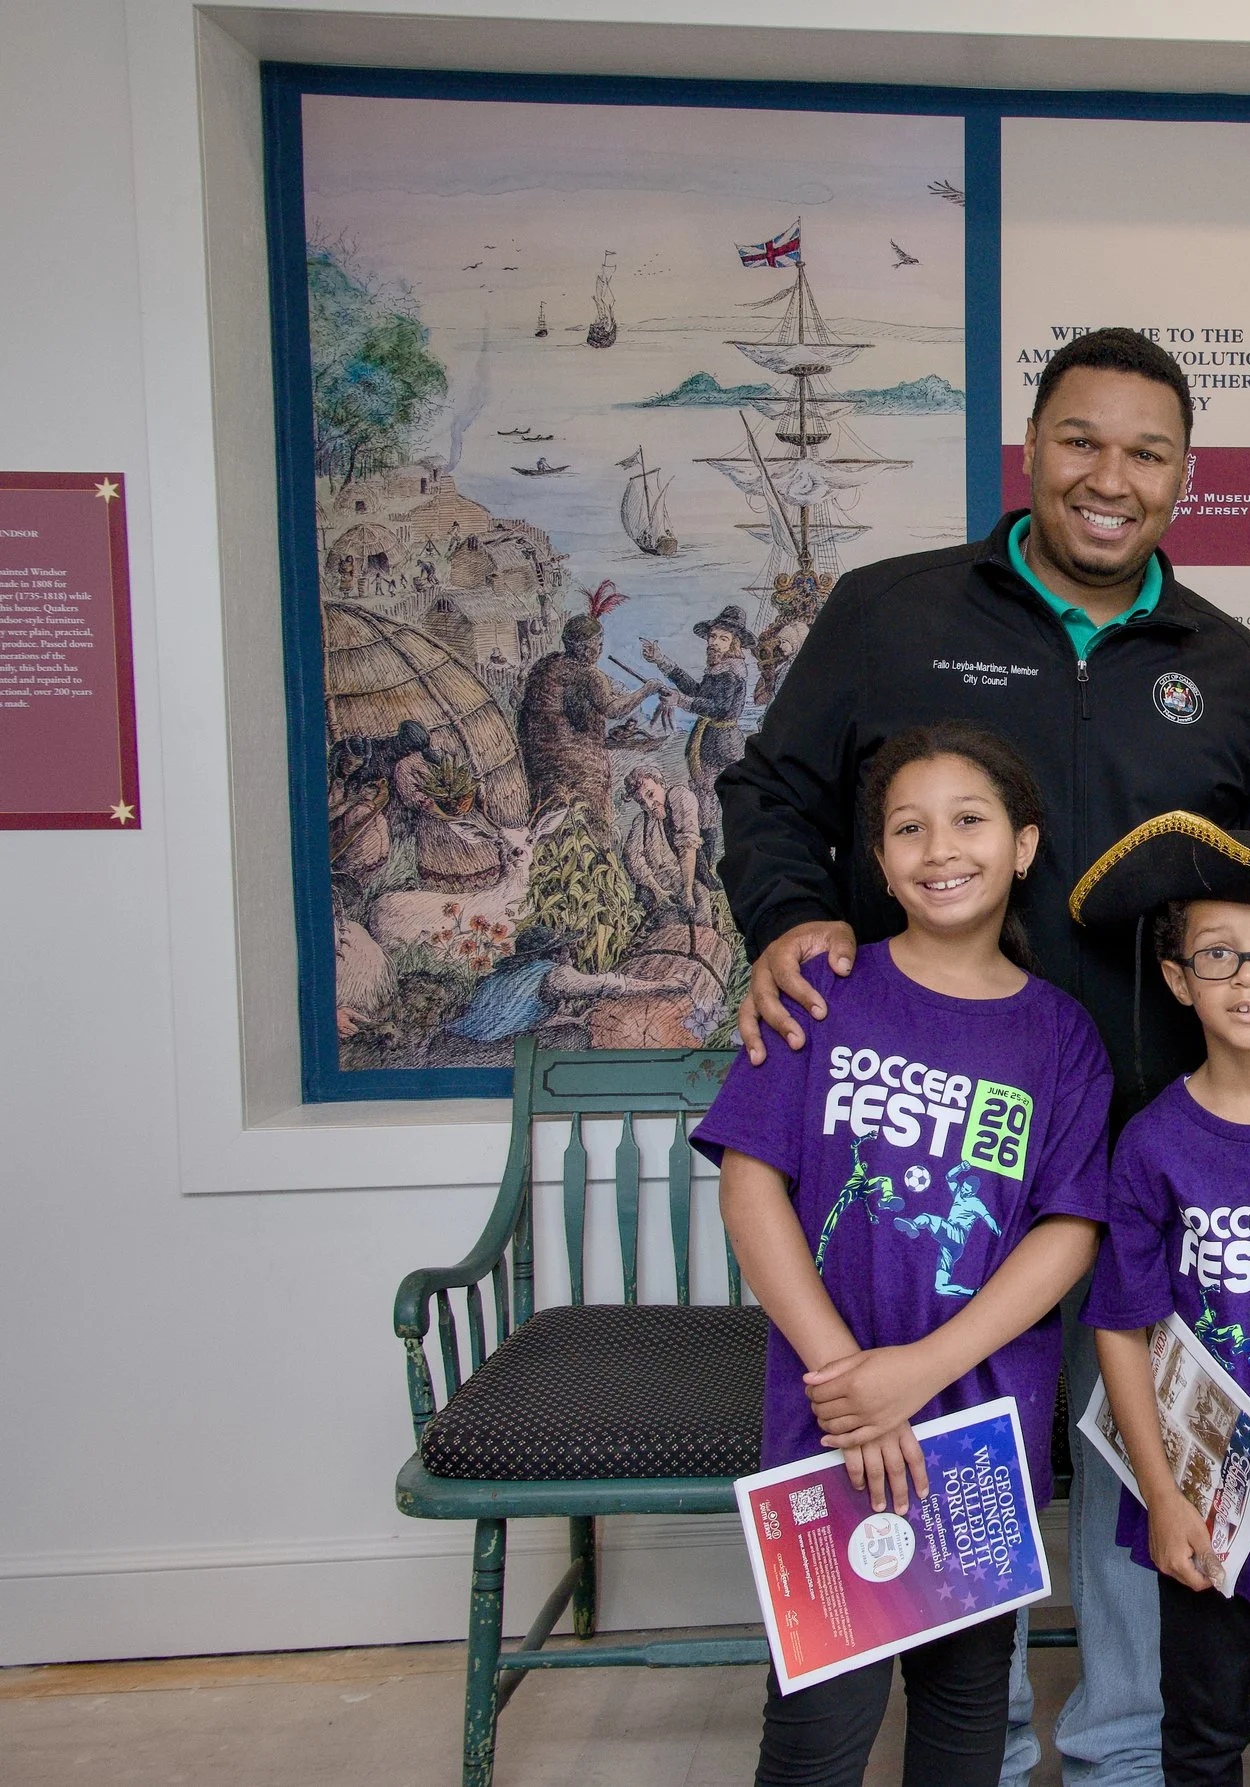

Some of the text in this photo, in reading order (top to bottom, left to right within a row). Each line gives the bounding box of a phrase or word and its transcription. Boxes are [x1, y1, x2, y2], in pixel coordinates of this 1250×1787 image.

[1166, 328, 1195, 343] TO
[1201, 328, 1244, 343] THE
[1197, 505, 1249, 515] JERSEY
[0, 530, 39, 538] INDSOR
[0, 567, 67, 576] ainted Windsor
[20, 580, 29, 588] in
[32, 580, 53, 588] 1808
[54, 580, 67, 588] for
[69, 591, 92, 600] while
[0, 604, 79, 614] his house. Quakers
[0, 615, 85, 626] ndsor-style furniture
[28, 627, 53, 638] plain,
[55, 627, 94, 638] practical,
[2, 640, 94, 650] produce. Passed down
[41, 652, 51, 660] of
[52, 652, 66, 660] the
[19, 664, 35, 672] this
[36, 664, 62, 672] bench
[64, 664, 78, 672] has
[1010, 664, 1039, 676] Member
[19, 676, 35, 684] and
[37, 676, 71, 686] repaired
[963, 673, 1008, 686] City Council
[0, 688, 32, 696] ctional,
[53, 688, 70, 696] 200
[71, 690, 93, 698] years
[4, 700, 30, 708] made.
[829, 1046, 972, 1108] SOCCER
[987, 1087, 1010, 1098] JUNE
[823, 1082, 966, 1158] FEST
[979, 1098, 1027, 1136] 20
[972, 1130, 1019, 1168] 26
[1153, 1330, 1168, 1357] CCHA
[1213, 1451, 1250, 1526] Heritage
[759, 1502, 768, 1520] SOUTH
[973, 1445, 1012, 1577] WASHINGTON
[993, 1465, 1022, 1547] GEORGE
[919, 1504, 935, 1532] highly
[942, 1467, 976, 1576] PORK ROLL
[959, 1466, 992, 1566] CALLED IT
[763, 1521, 772, 1540] JERSEY
[930, 1493, 951, 1561] (not confirmed,
[864, 1518, 897, 1578] 250
[925, 1533, 943, 1572] possible)
[780, 1575, 791, 1598] county
